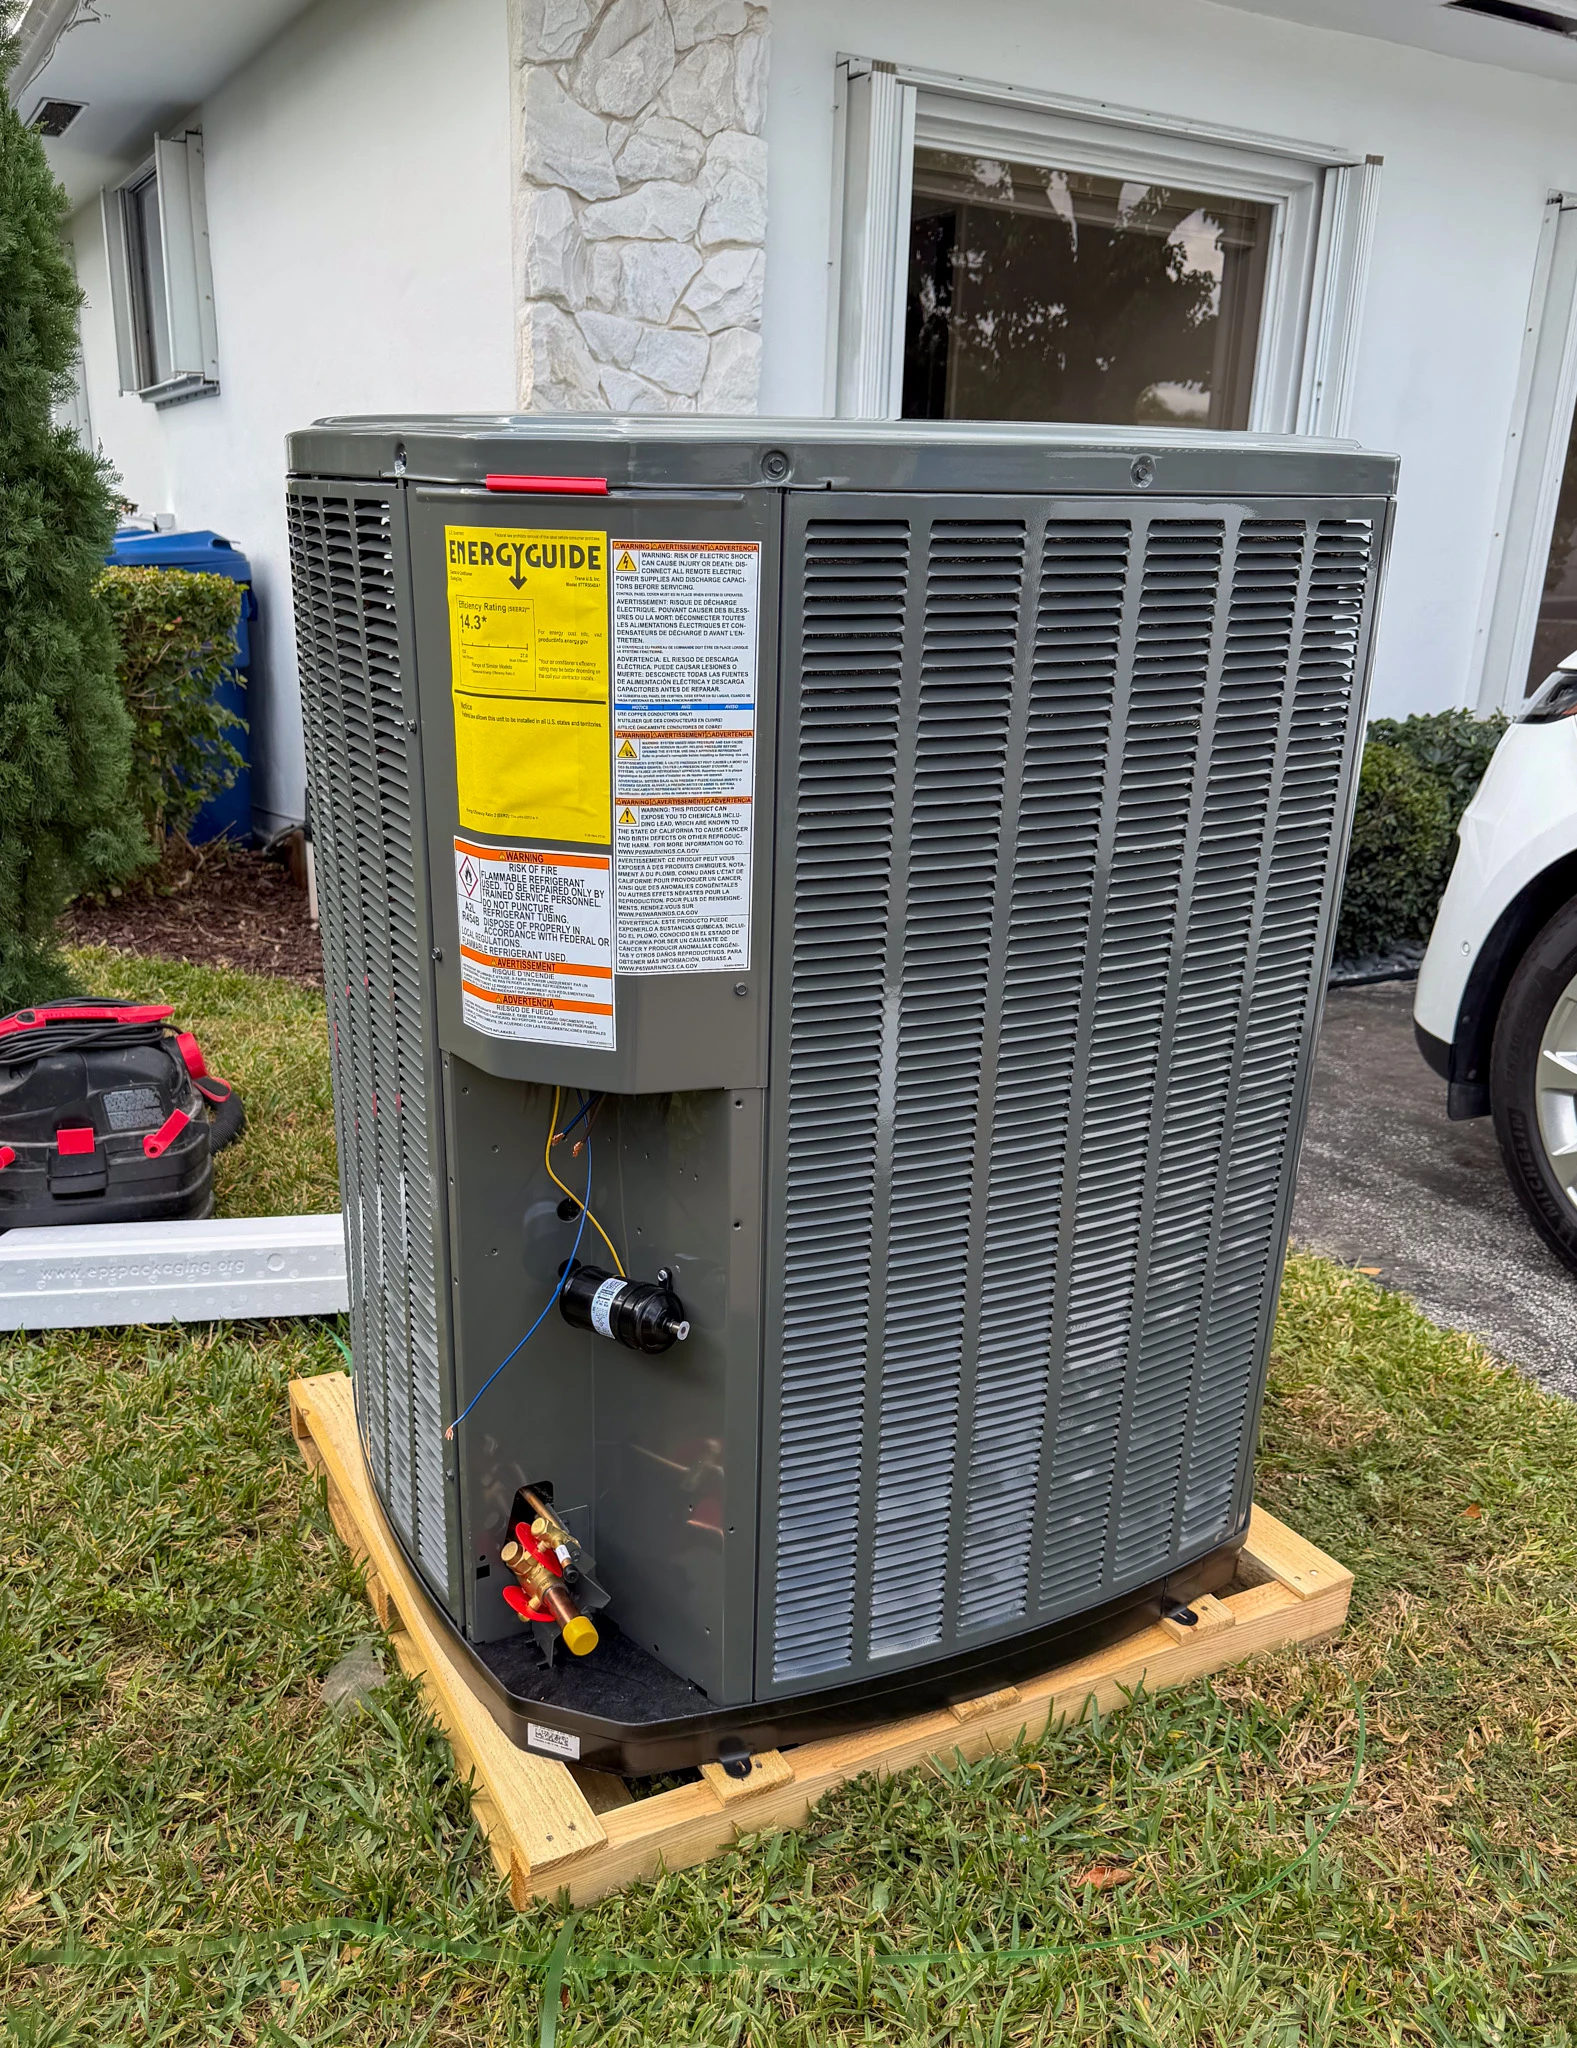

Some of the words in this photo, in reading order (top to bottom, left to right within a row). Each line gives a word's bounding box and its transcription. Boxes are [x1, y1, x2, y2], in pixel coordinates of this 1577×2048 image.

[449, 540, 601, 570] ENERGYGUIDE
[484, 603, 506, 613] Rating
[703, 598, 737, 606] DÉCHARGE
[506, 852, 544, 863] WARNING
[509, 863, 527, 873] RISK
[528, 864, 539, 874] OF
[541, 866, 558, 876] FIRE
[481, 870, 527, 883] FLAMMABLE
[529, 875, 585, 888] REFRIGERANT
[482, 879, 502, 890] USED.
[504, 882, 515, 891] TO
[517, 883, 527, 892] BE
[529, 884, 569, 896] REPAIRED
[571, 888, 592, 898] ONLY
[594, 890, 605, 899] BY
[482, 889, 513, 900] TRAINED
[513, 891, 549, 903] SERVICE
[551, 895, 601, 907] PERSONNEL.
[483, 899, 492, 908] DO
[493, 901, 509, 910] NOT
[512, 902, 554, 913] PUNCTURE
[465, 901, 476, 914] A2L
[483, 907, 535, 921] REFRIGERANT
[537, 913, 569, 924] TUBING.
[462, 911, 480, 926] R454B
[484, 917, 515, 929] DISPOSE
[517, 921, 527, 930] OF
[530, 922, 571, 934] PROPERLY
[573, 926, 580, 935] IN
[462, 926, 475, 939] LOCAL
[475, 932, 522, 948] REGULATIONS.
[484, 927, 536, 940] ACCORDANCE
[537, 932, 558, 942] WITH
[560, 934, 596, 946] FEDERAL
[598, 938, 610, 946] OR
[462, 936, 488, 954] FLAMMABLE
[489, 946, 543, 960] REFRIGERANT
[545, 952, 568, 962] USED.
[497, 958, 556, 972] AVERTISSEMENT
[492, 968, 516, 976] RISQUE
[517, 970, 555, 980] D'INCENDIE
[503, 995, 555, 1009] ADVERTENCIA
[496, 1005, 520, 1013] RIESGO
[532, 1008, 554, 1016] FUEGO
[1511, 1113, 1560, 1219] MICHELIN
[40, 1259, 245, 1280] www.epspackaging.org
